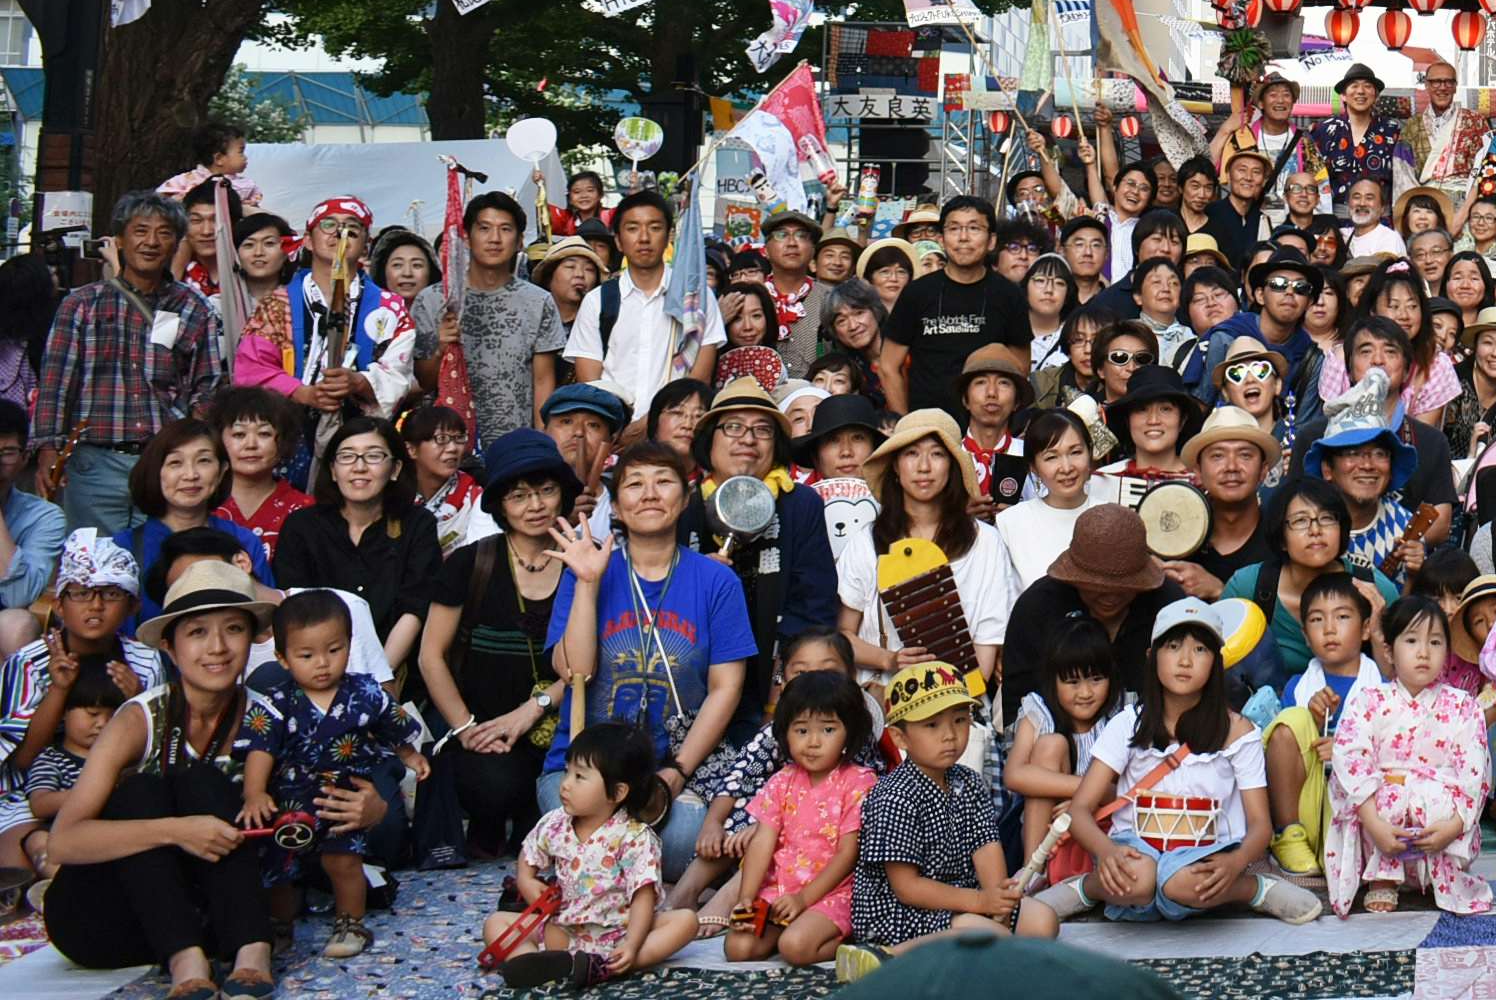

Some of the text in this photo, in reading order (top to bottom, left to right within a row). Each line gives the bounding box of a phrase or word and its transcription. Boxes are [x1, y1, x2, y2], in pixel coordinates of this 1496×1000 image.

[832, 96, 932, 120] 大友良英
[923, 325, 938, 336] Art
